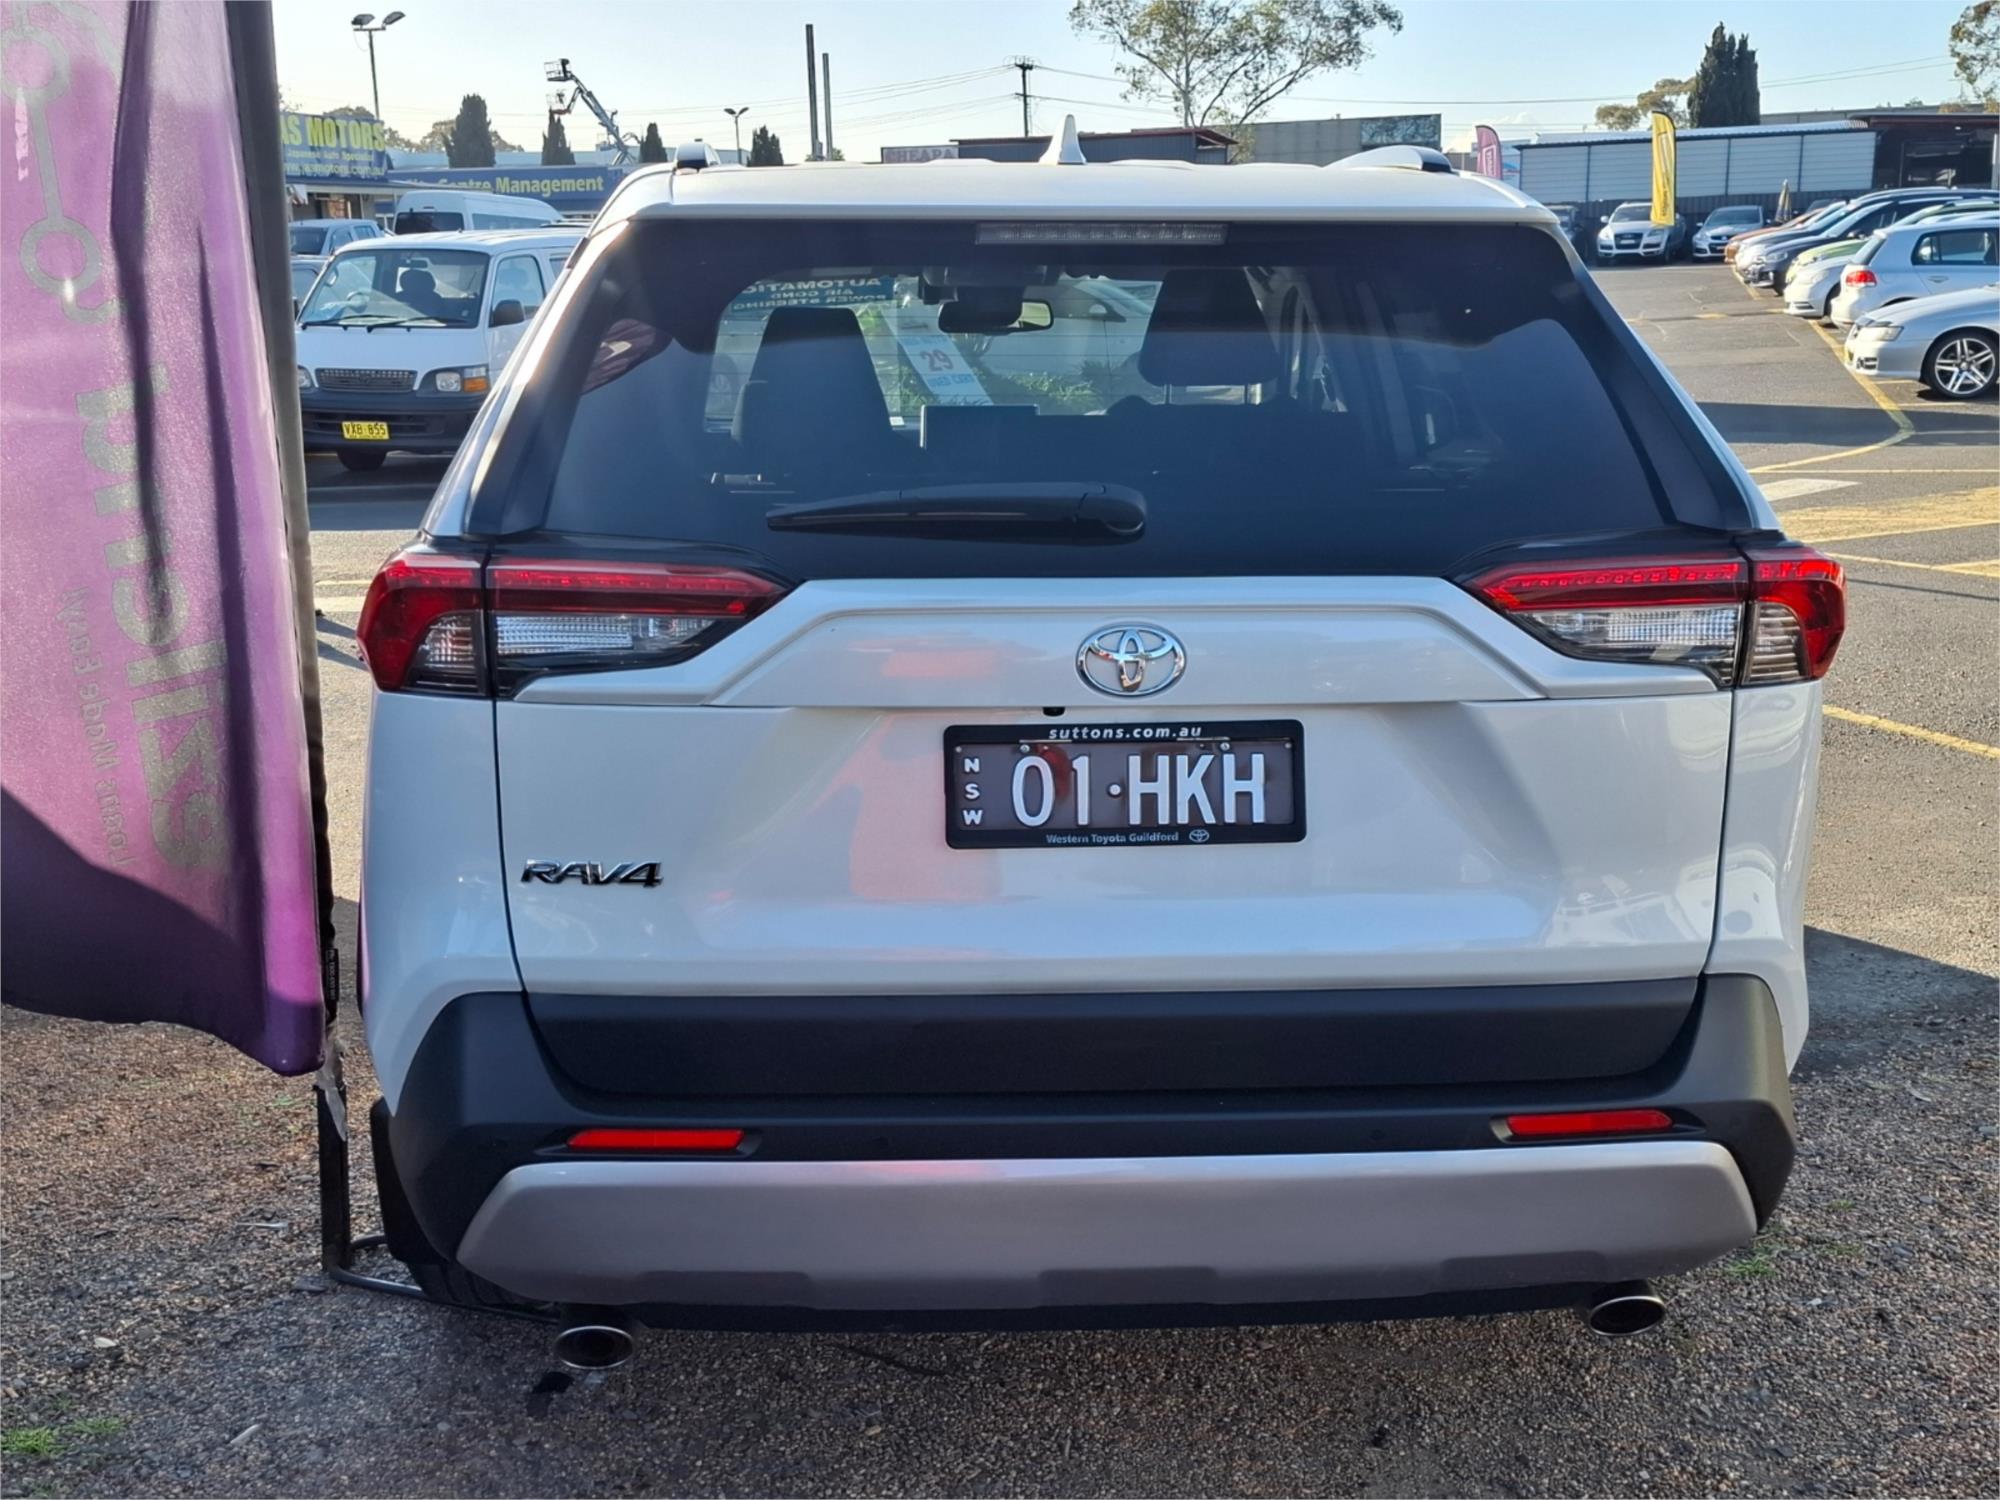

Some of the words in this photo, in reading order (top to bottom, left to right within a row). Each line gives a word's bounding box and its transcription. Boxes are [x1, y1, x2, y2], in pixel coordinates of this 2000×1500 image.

[305, 117, 386, 152] MOTORS
[496, 174, 604, 197] Management
[1049, 725, 1202, 740] suttons.com.au
[1046, 834, 1089, 844] Western
[1091, 833, 1126, 846] Toyota
[1129, 831, 1179, 843] Guildford
[521, 859, 664, 887] RAV4
